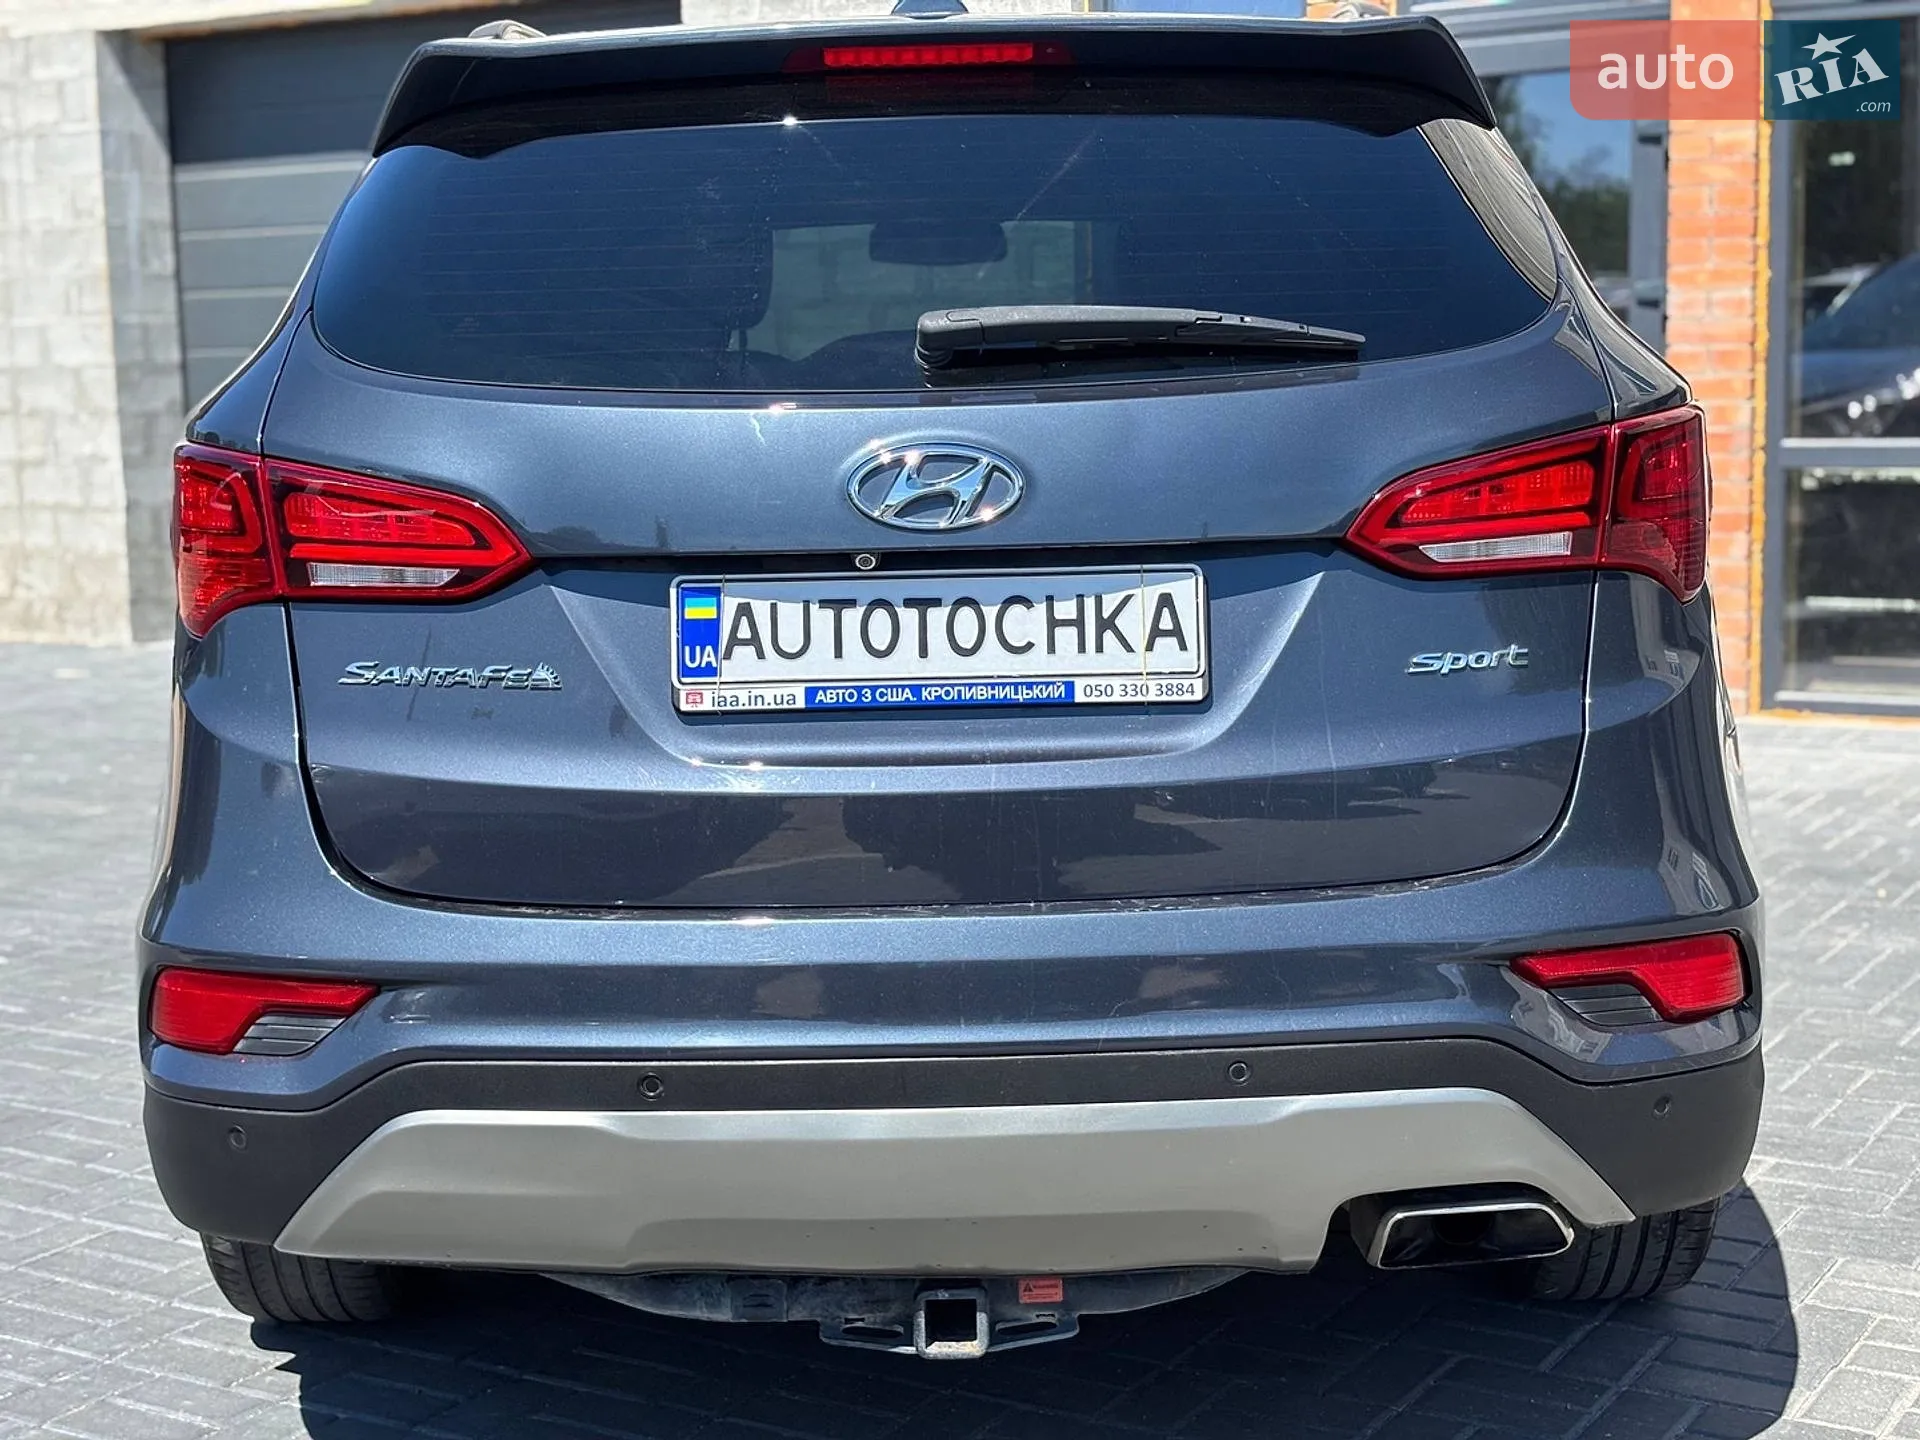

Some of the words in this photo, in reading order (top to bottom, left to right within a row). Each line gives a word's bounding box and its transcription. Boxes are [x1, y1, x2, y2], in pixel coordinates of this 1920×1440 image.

[722, 592, 1188, 660] AUTOTOCHKA
[685, 645, 717, 668] UA
[711, 690, 796, 708] iaa.in.ua
[815, 689, 858, 704] АВТО
[875, 687, 917, 702] США.
[921, 681, 1066, 702] КРОПИВНИЦЬКИЙ
[1083, 683, 1114, 698] 050
[1119, 682, 1150, 698] 330
[1154, 682, 1195, 697] 3884
